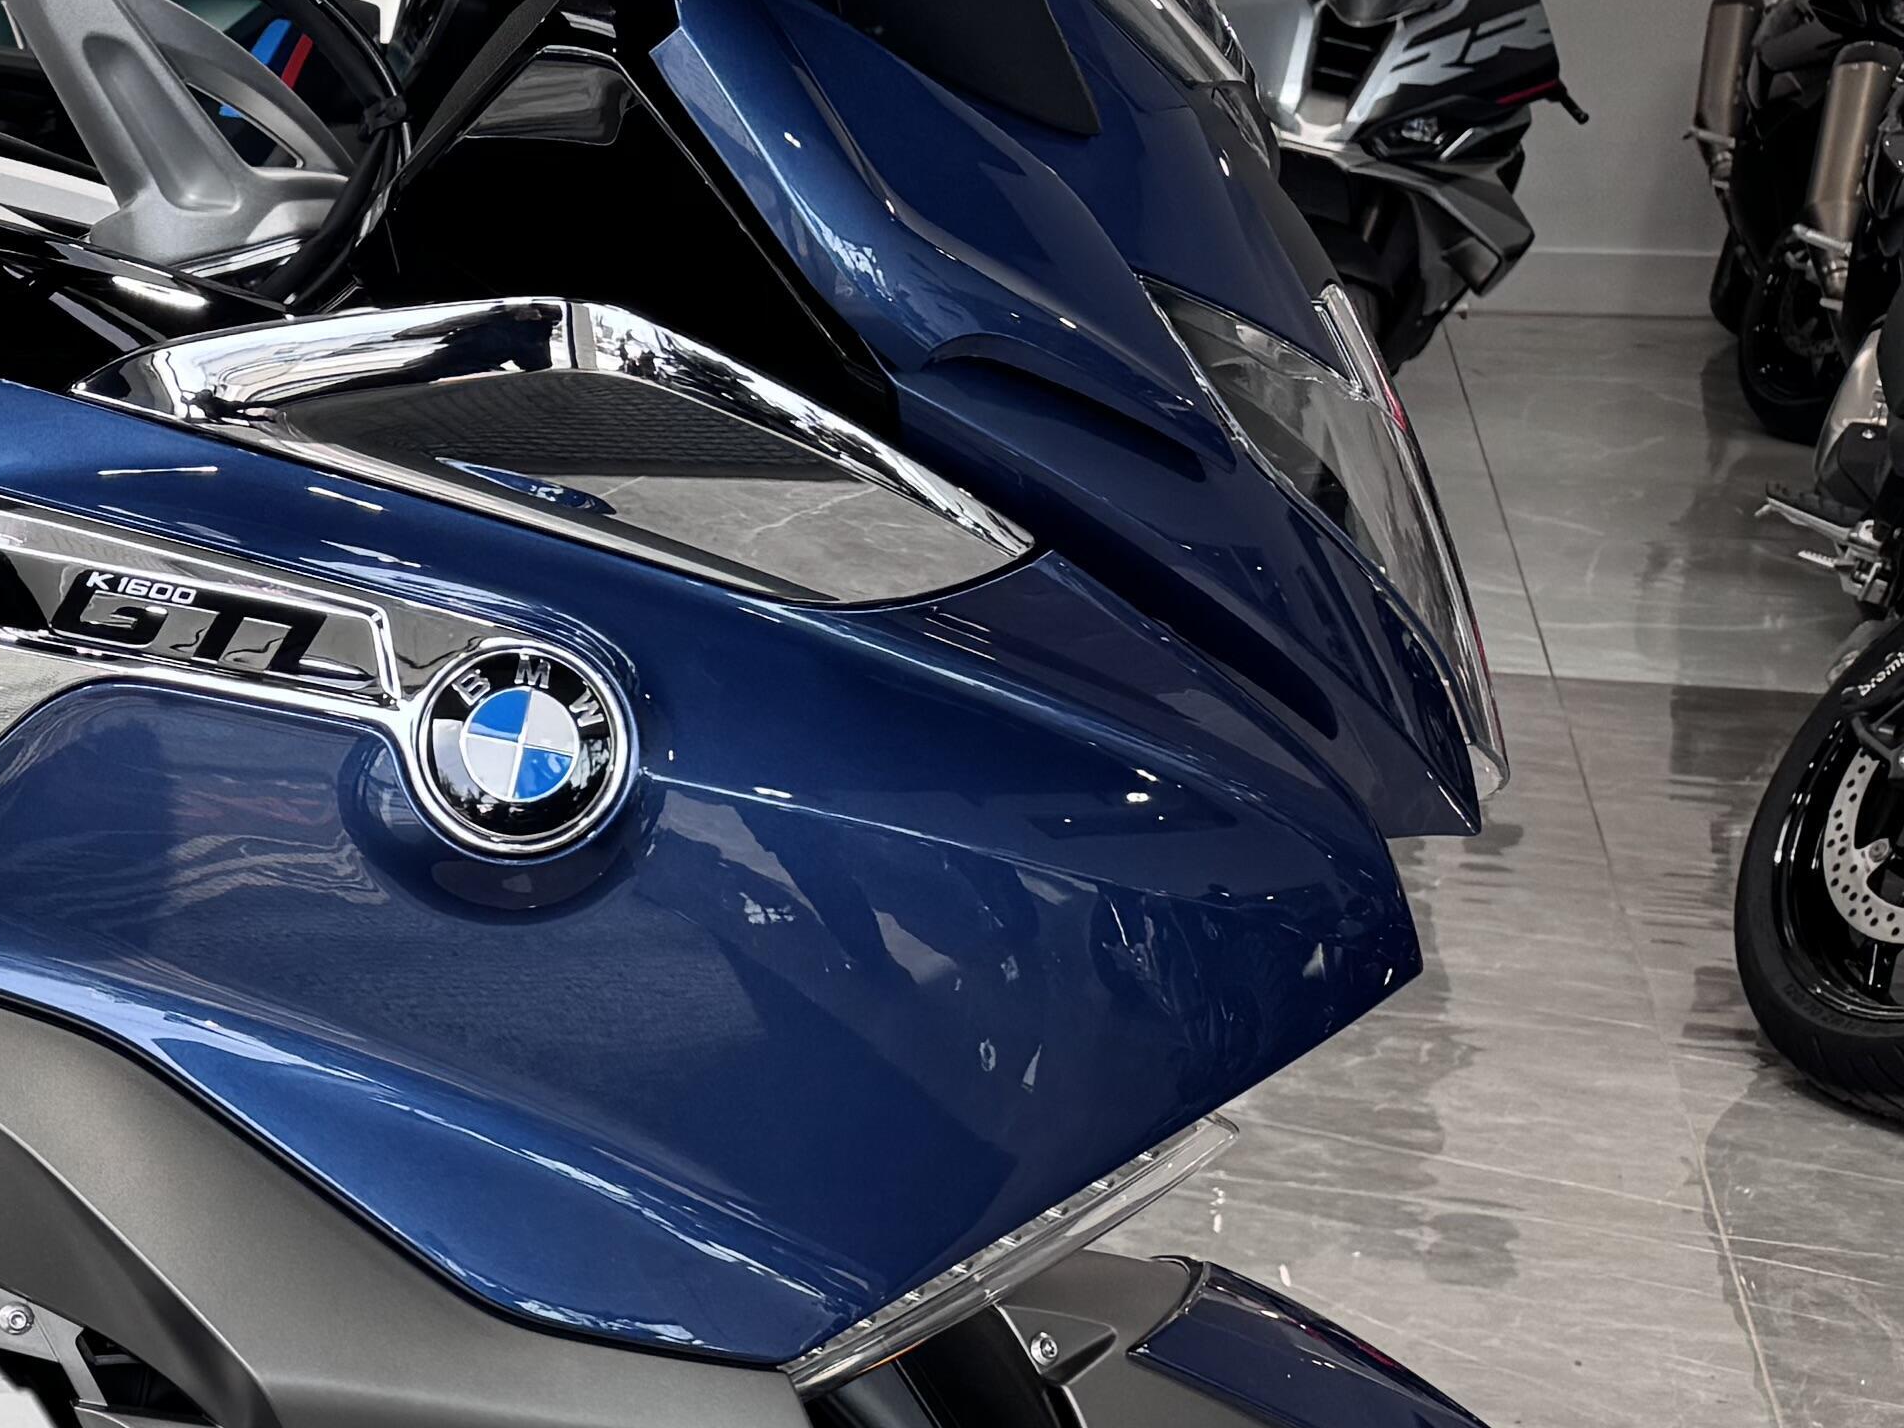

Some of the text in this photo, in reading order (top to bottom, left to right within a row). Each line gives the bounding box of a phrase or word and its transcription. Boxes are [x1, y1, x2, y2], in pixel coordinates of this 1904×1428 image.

[86, 571, 197, 604] K 1600
[453, 653, 607, 729] BMW
